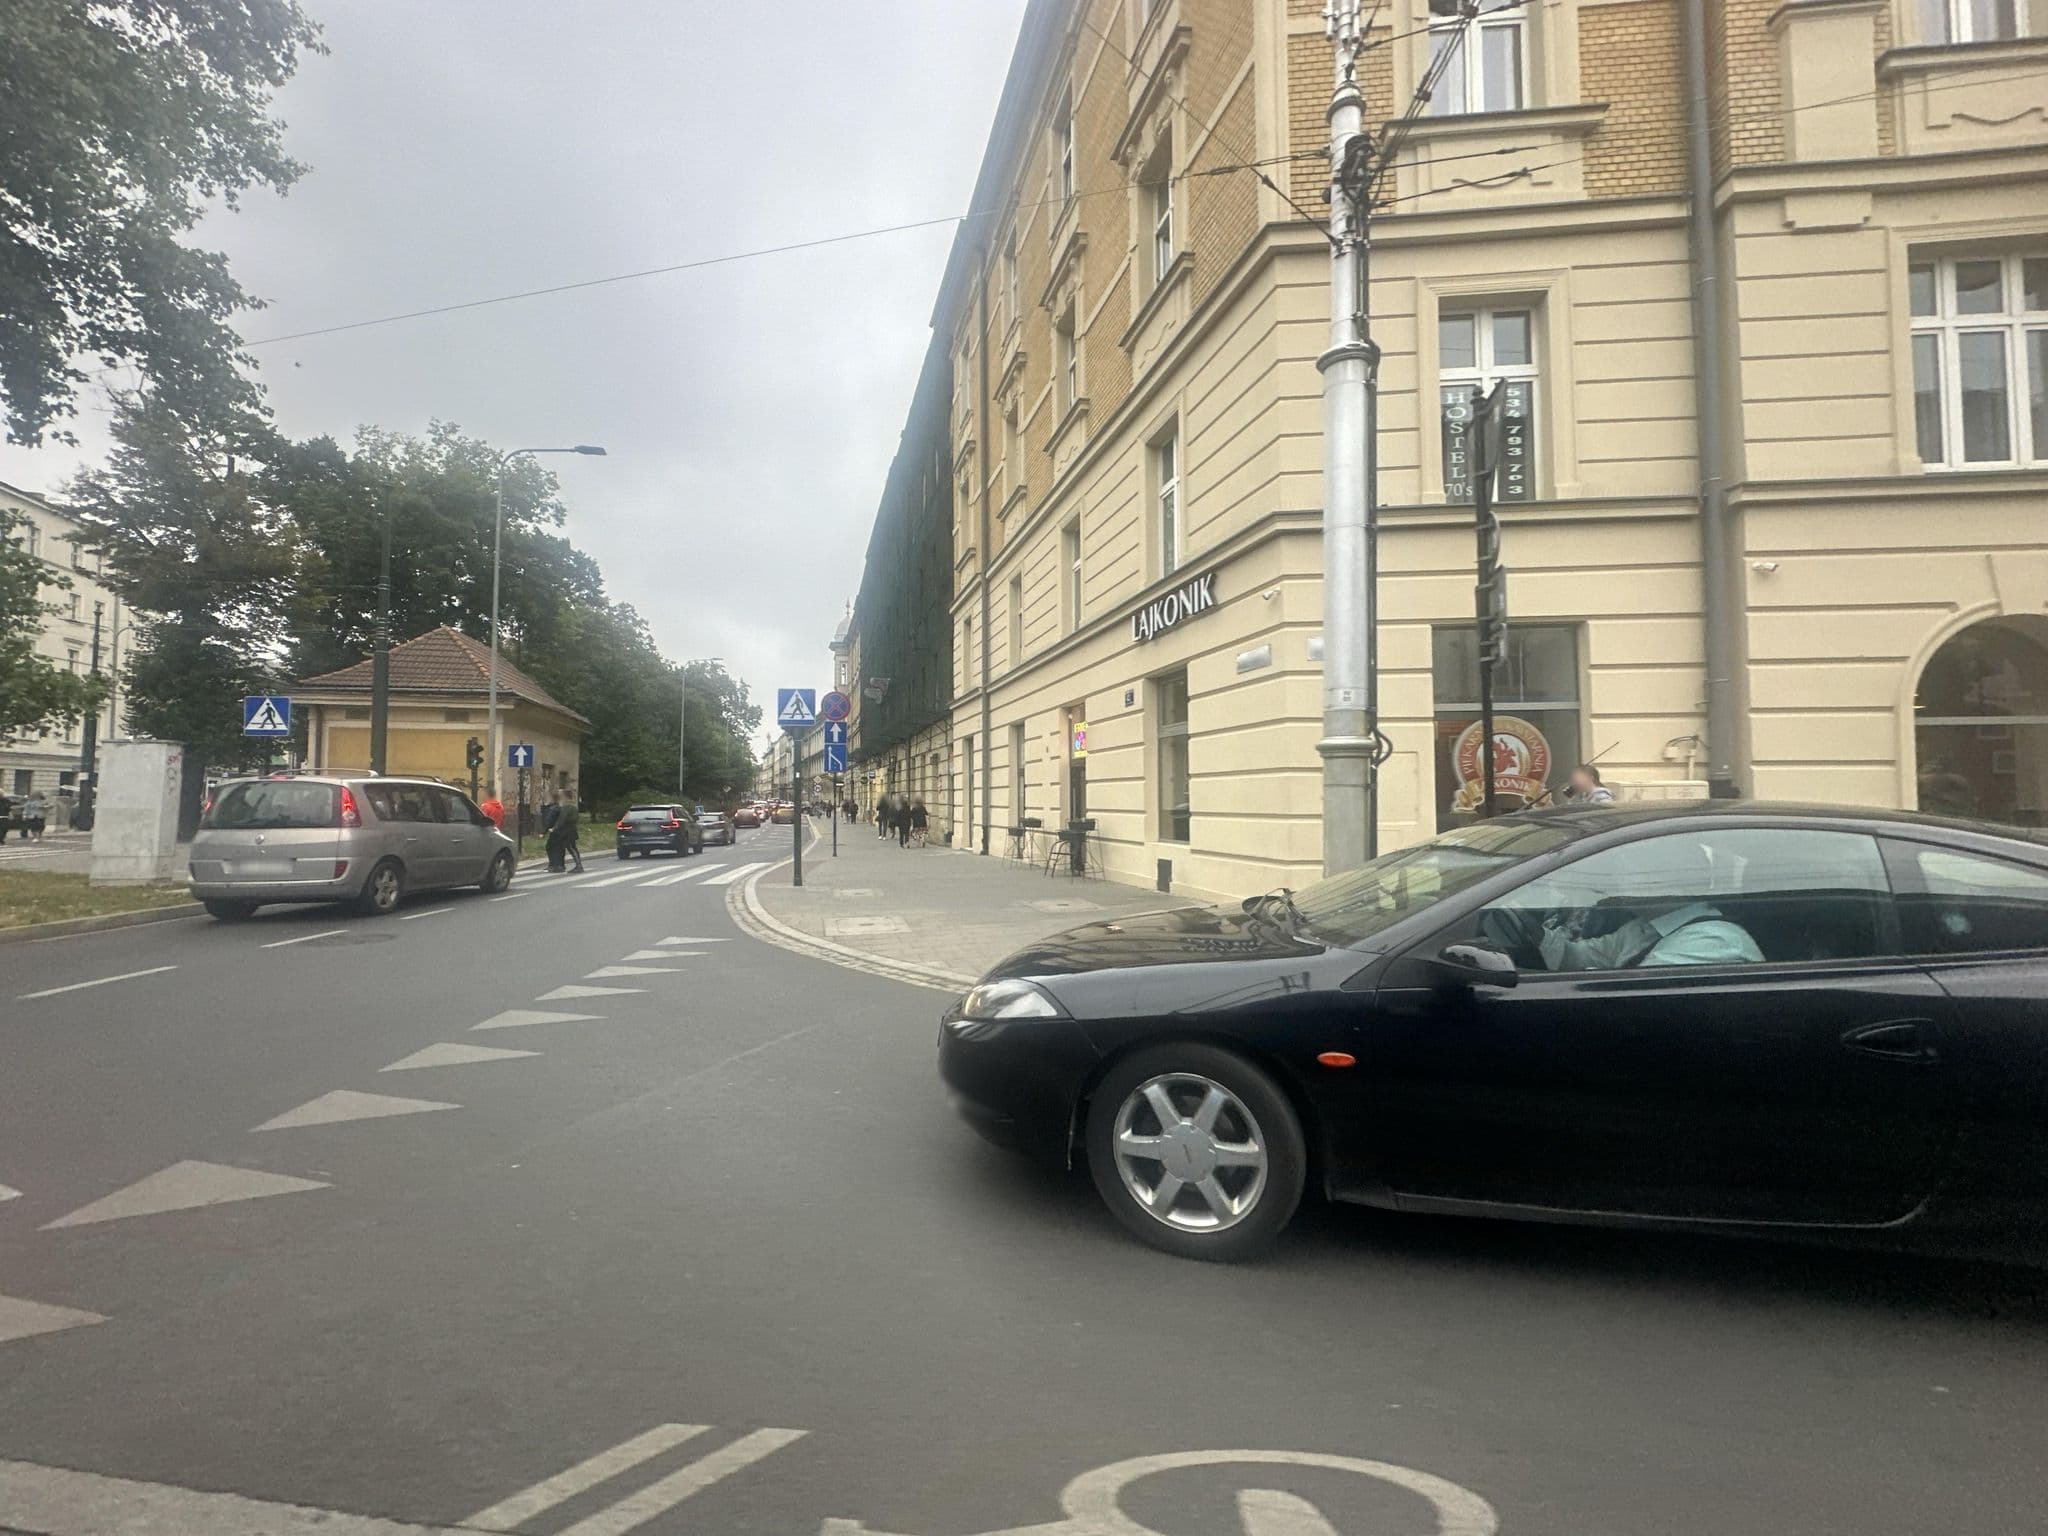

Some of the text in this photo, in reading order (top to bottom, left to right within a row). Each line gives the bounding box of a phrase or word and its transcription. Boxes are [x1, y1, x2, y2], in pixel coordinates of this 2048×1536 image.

[1446, 392, 1466, 478] HOSTEL
[1506, 387, 1524, 494] 534 793 703
[1445, 482, 1473, 496] 70's
[1132, 573, 1213, 640] LAJKONIK
